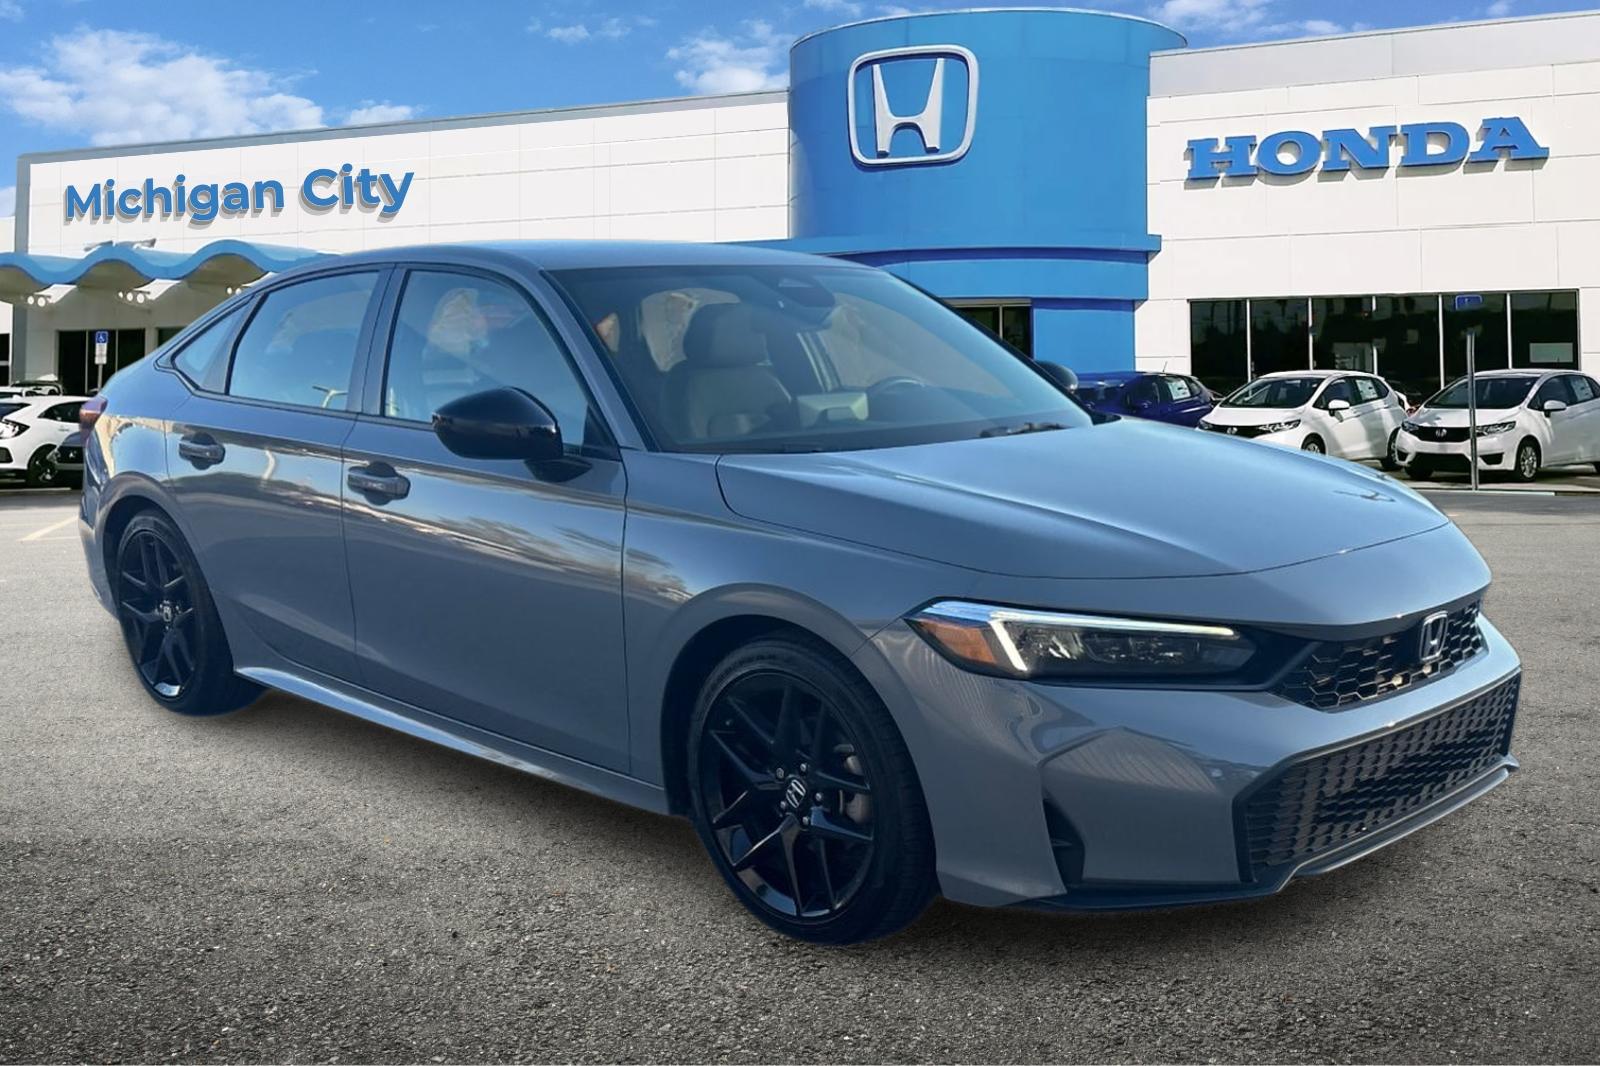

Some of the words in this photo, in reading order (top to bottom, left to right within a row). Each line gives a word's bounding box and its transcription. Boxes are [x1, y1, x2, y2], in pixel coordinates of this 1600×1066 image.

[1186, 116, 1550, 180] HONDA
[66, 174, 285, 222] Michigan
[303, 163, 415, 214] City
